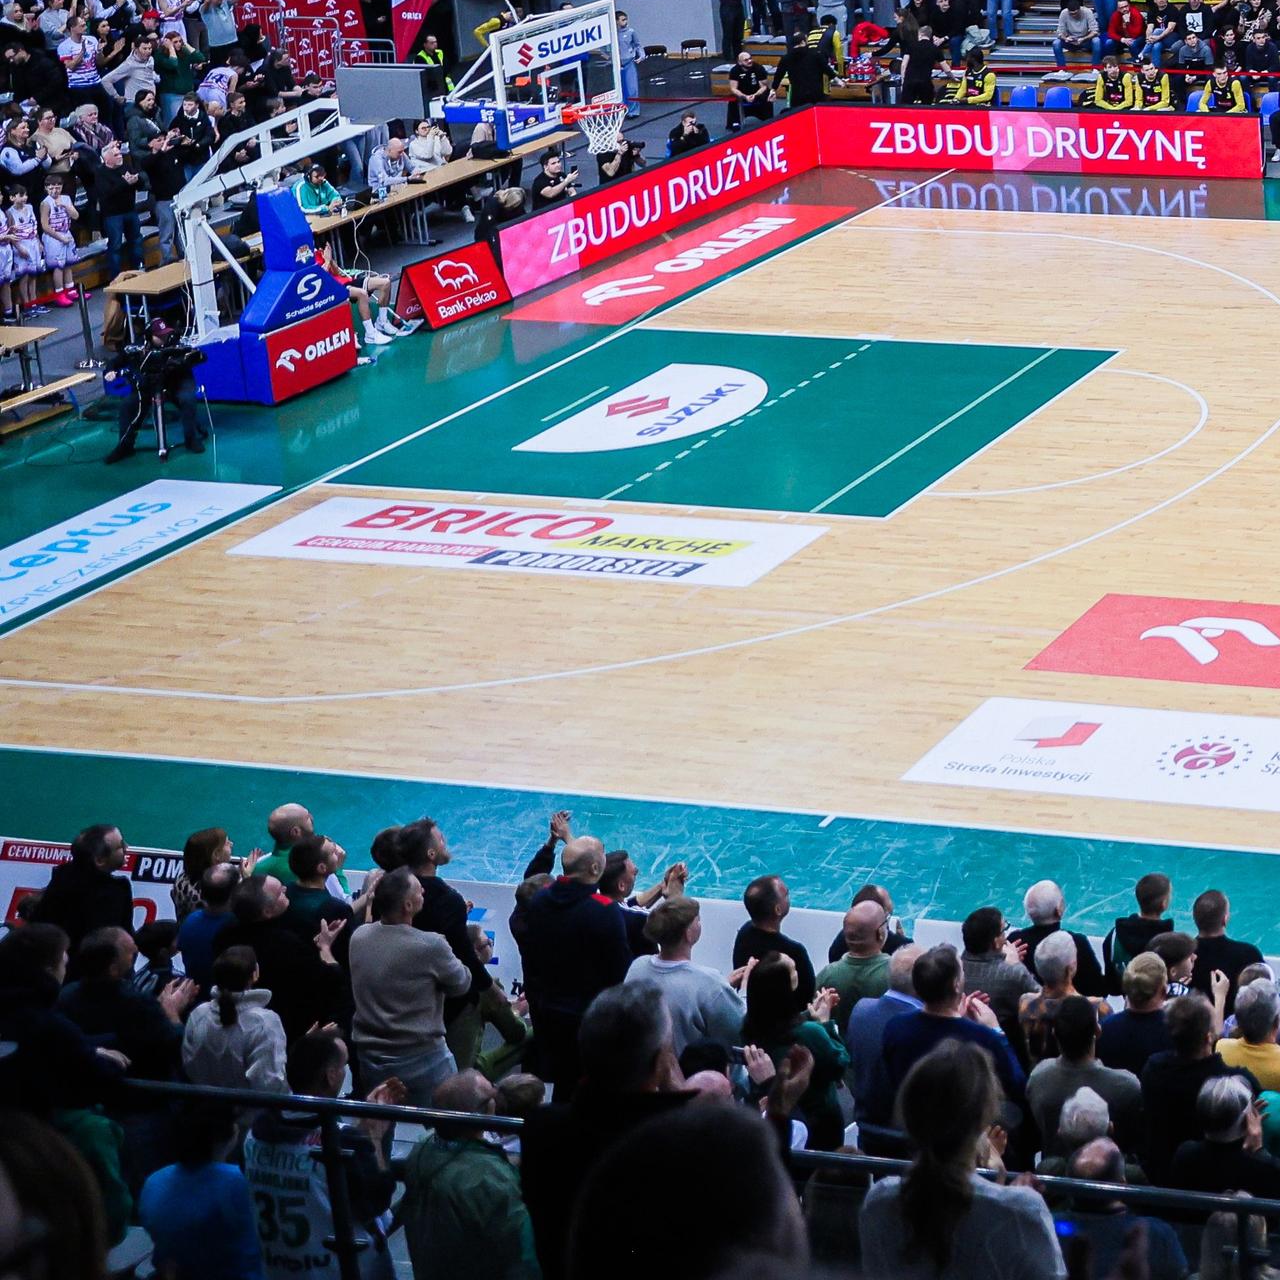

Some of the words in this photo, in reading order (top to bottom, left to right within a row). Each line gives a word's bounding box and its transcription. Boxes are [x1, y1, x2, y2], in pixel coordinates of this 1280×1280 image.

[536, 24, 603, 59] SUZUKI
[869, 122, 1015, 160] ZBUDUJ
[1027, 120, 1207, 170] DRUŻYNĘ
[547, 199, 662, 265] ZBUDUJ
[668, 134, 788, 214] DRUŻYNĘ
[653, 216, 798, 273] ORLEN
[285, 303, 314, 320] Schelde
[314, 294, 335, 308] Sports
[438, 303, 466, 320] Bank
[466, 290, 497, 310] Pekao
[304, 327, 351, 361] ORLEN
[636, 381, 746, 438] SUZUKI
[199, 506, 225, 517] IT
[343, 503, 615, 541] BRICO
[580, 534, 732, 557] MARCHÉ
[304, 535, 395, 551] CENTRUM
[395, 540, 496, 557] HANDLOWE
[487, 550, 695, 577] POMORSKIE
[943, 761, 997, 776] Strefa
[999, 764, 1093, 784] Inwestycji
[998, 752, 1058, 767] Polska
